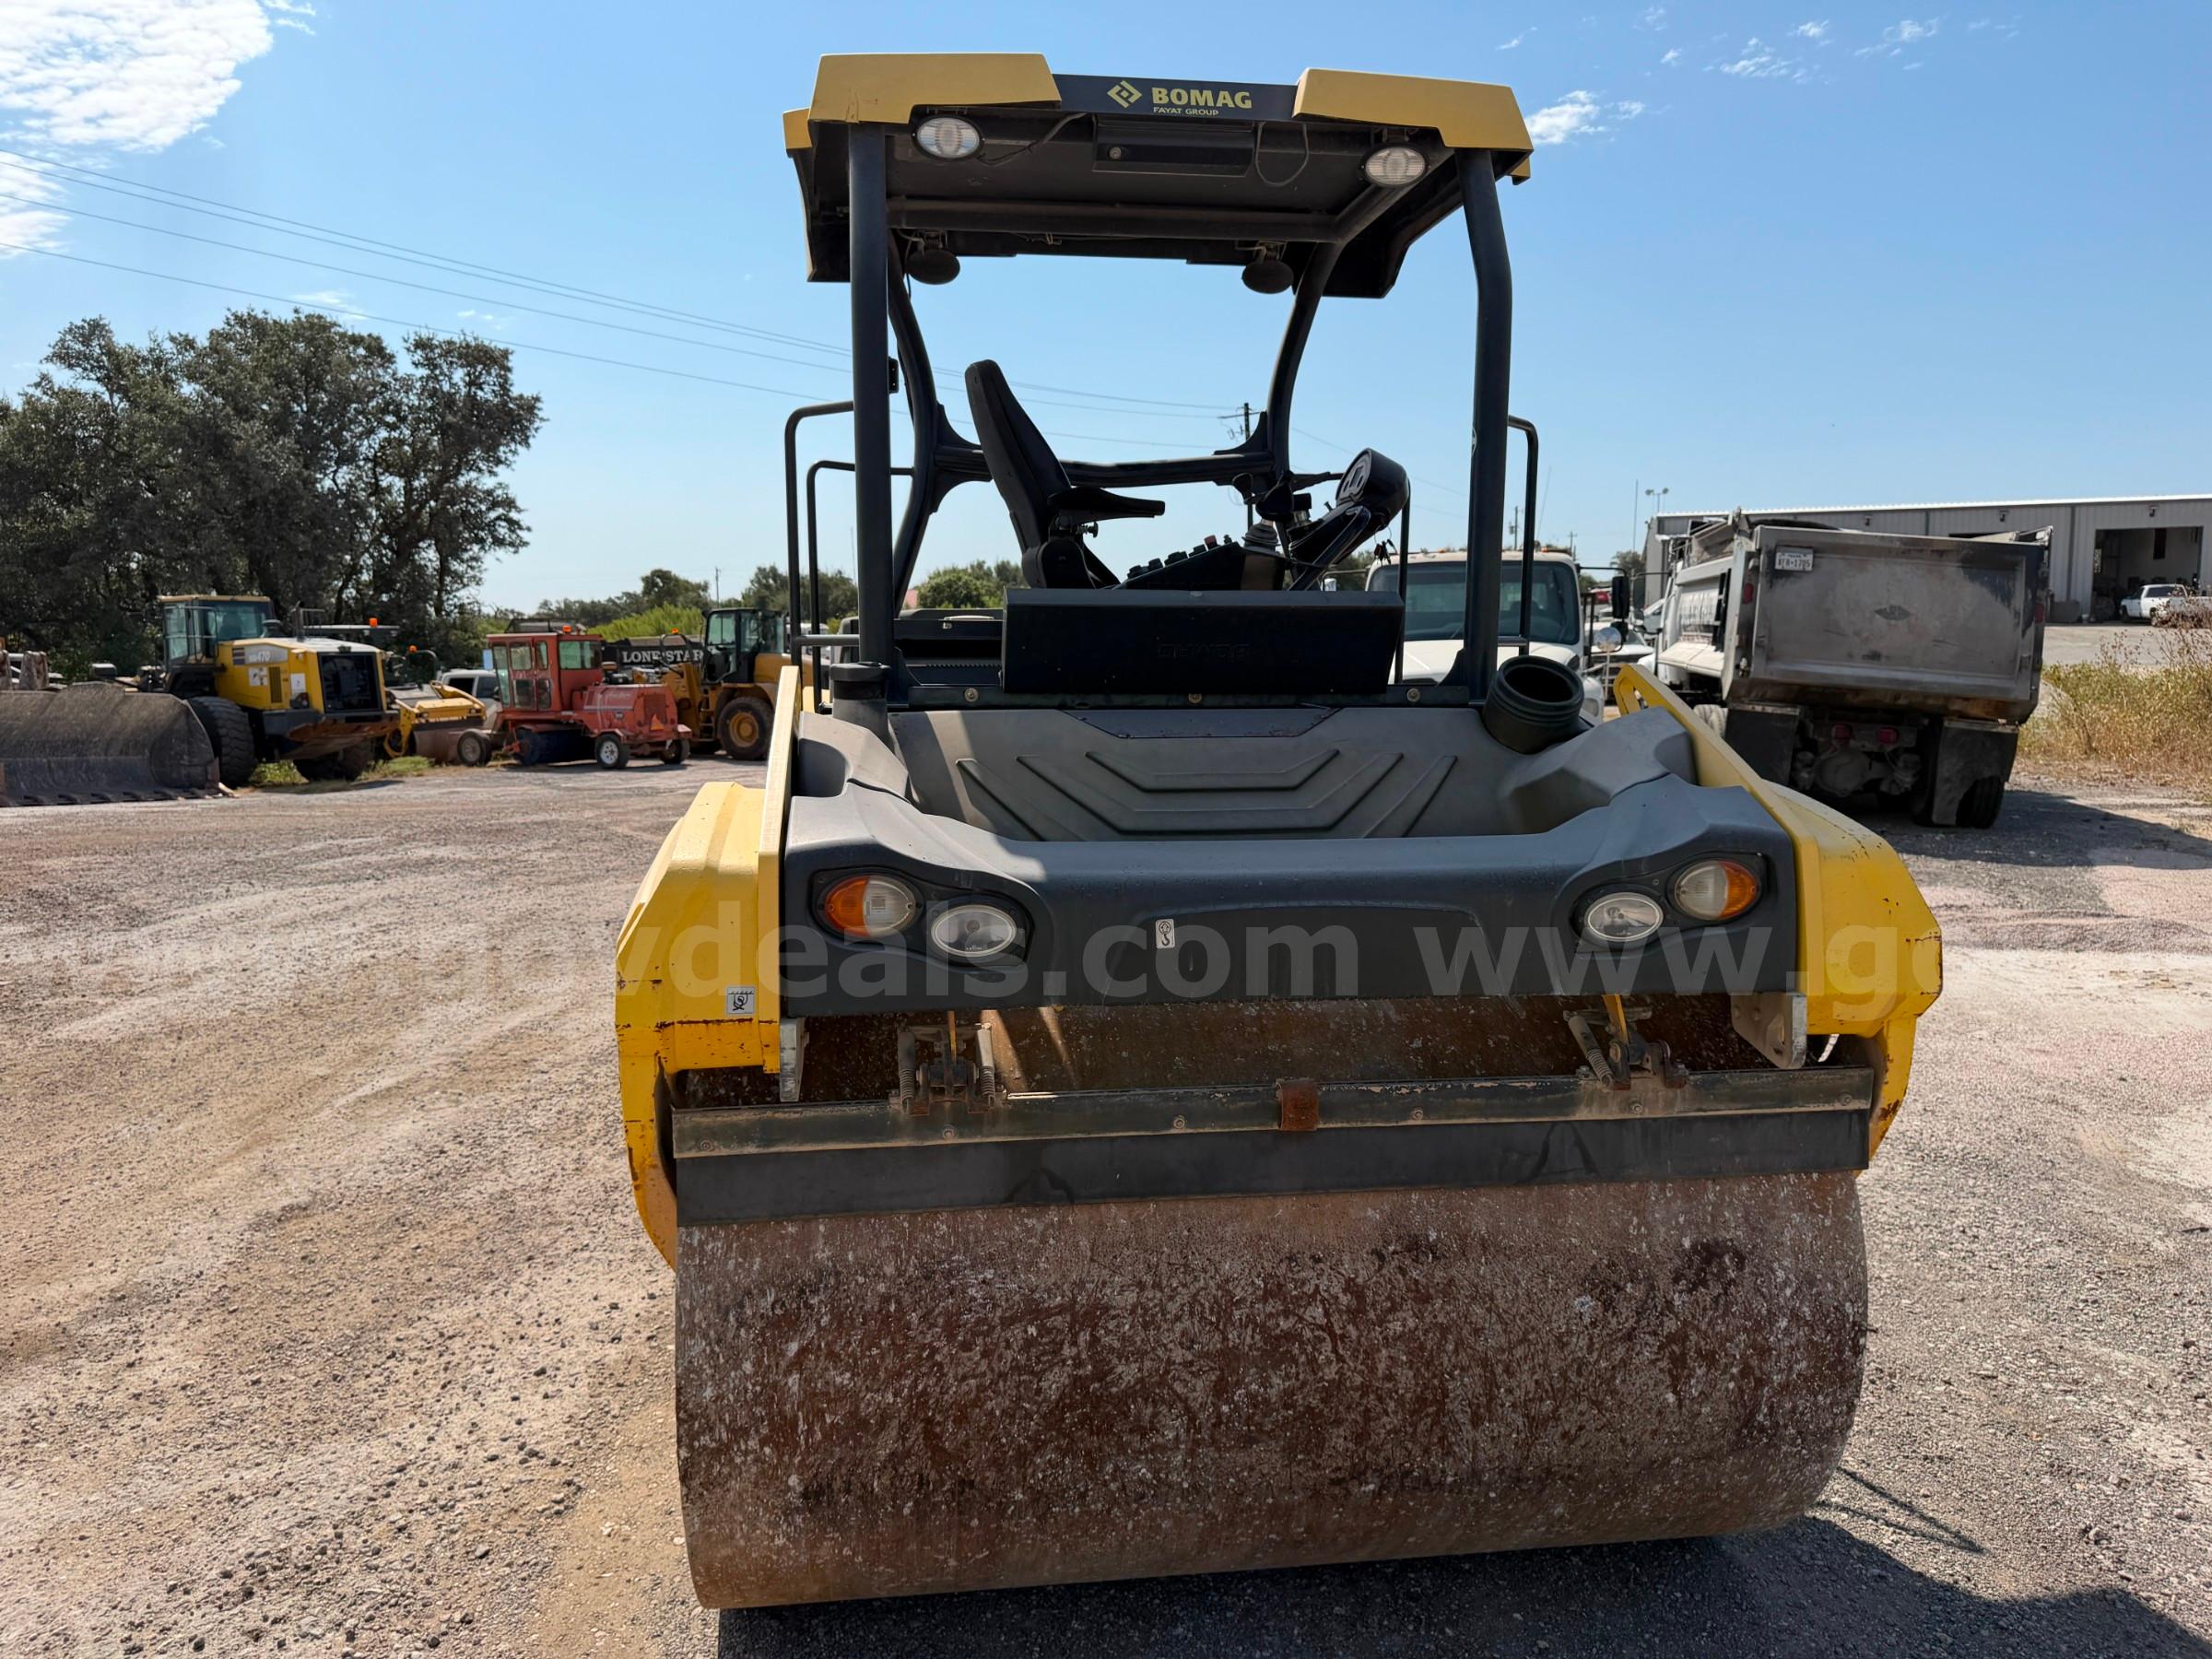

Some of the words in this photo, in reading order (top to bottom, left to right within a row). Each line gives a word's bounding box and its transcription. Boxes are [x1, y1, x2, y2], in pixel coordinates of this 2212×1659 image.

[1152, 87, 1253, 109] BOMAG
[1153, 106, 1182, 115] FAYAT
[1185, 108, 1218, 117] GROUP
